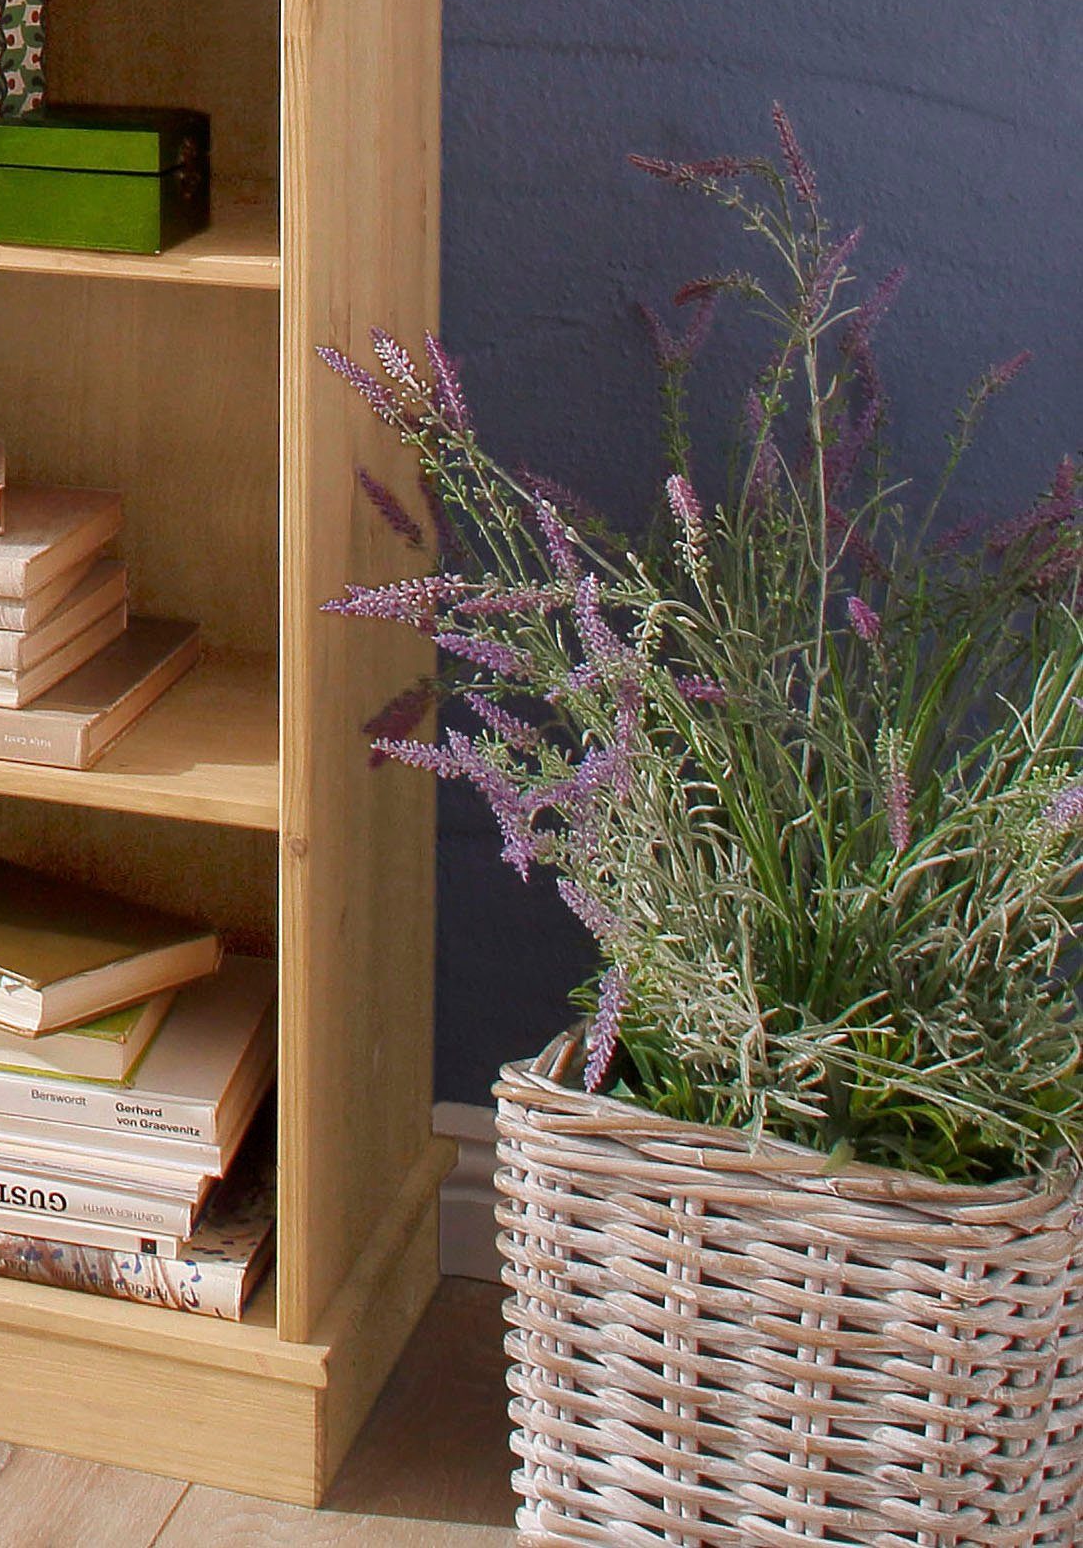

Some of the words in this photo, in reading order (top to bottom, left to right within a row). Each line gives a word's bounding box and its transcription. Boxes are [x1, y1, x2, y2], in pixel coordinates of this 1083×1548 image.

[31, 1089, 87, 1107] Berswordt
[115, 1102, 162, 1117] Gerhard
[116, 1116, 138, 1128] von
[140, 1118, 201, 1137] Graevenitz
